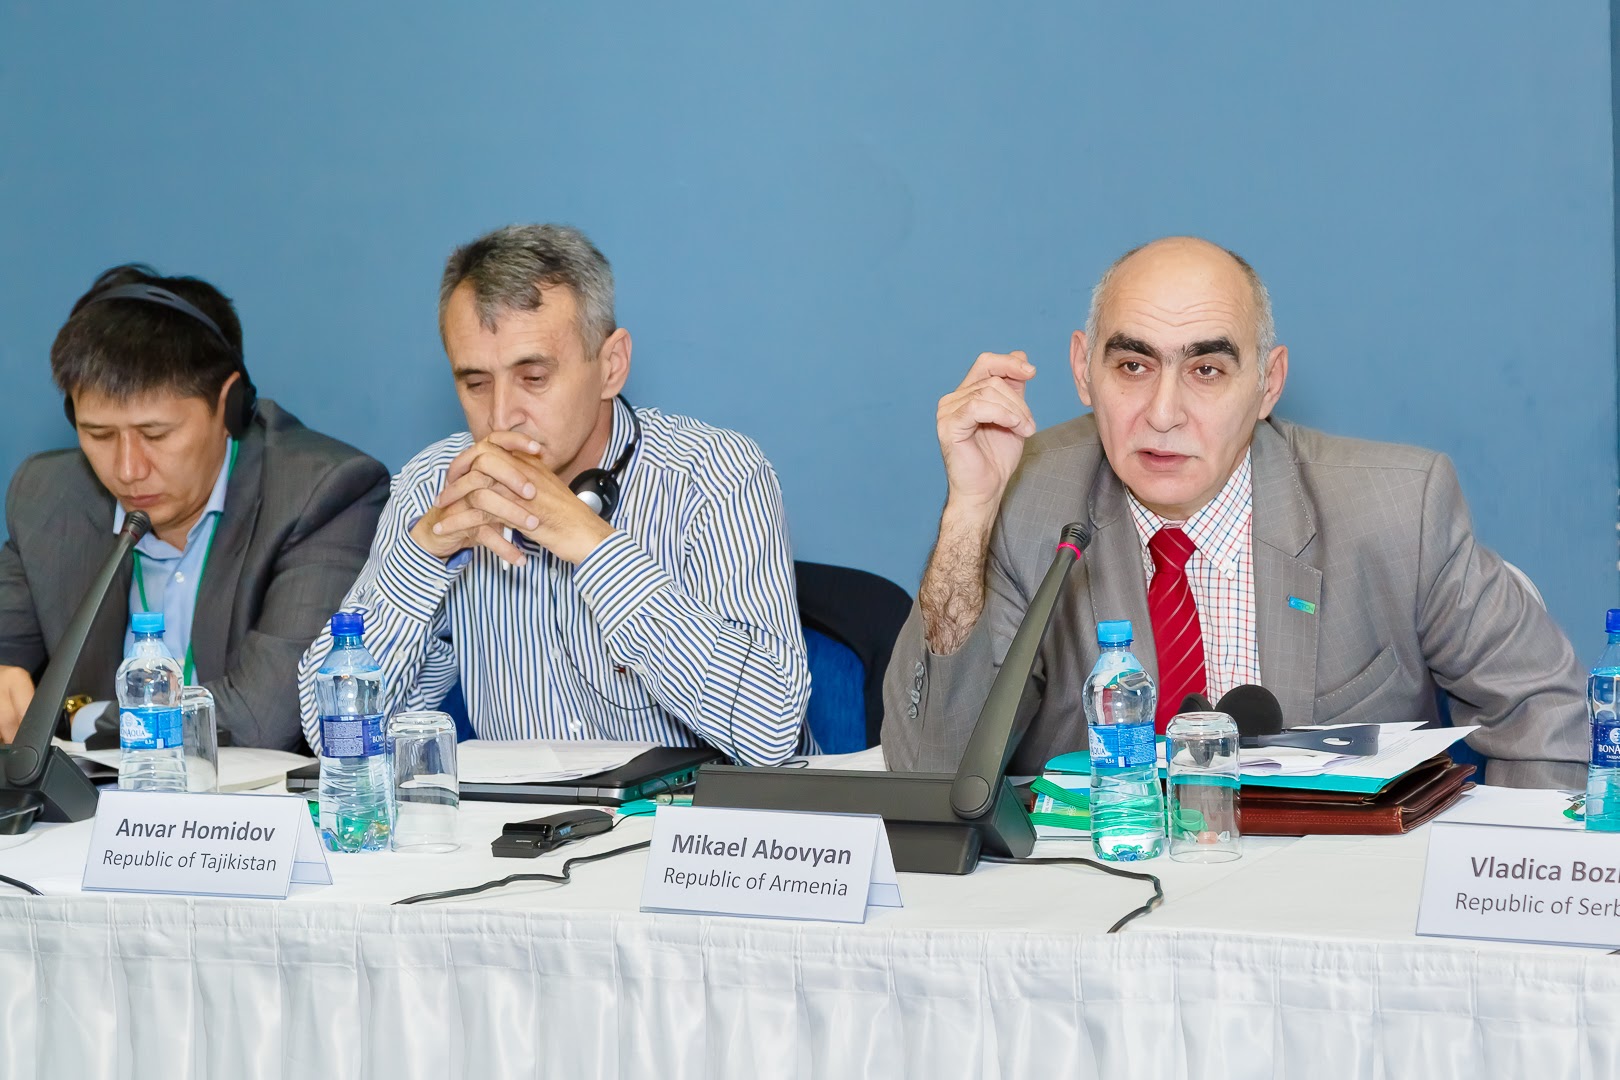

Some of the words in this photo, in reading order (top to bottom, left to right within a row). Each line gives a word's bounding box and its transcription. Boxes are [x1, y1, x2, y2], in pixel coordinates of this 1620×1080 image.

[115, 818, 177, 838] Anvar
[181, 820, 276, 842] Homidov
[102, 849, 174, 870] Republic
[177, 851, 197, 868] of
[200, 852, 277, 873] Tajikistan
[671, 834, 748, 858] Mikael
[751, 838, 852, 868] Abovyan
[663, 867, 741, 889] Republic
[746, 872, 767, 890] of
[769, 874, 848, 896] Armenia
[1471, 856, 1562, 881] Vladica
[1571, 861, 1620, 884] Boz
[1455, 892, 1545, 915] Republic
[1550, 896, 1574, 915] of
[1578, 898, 1620, 917] Serb
